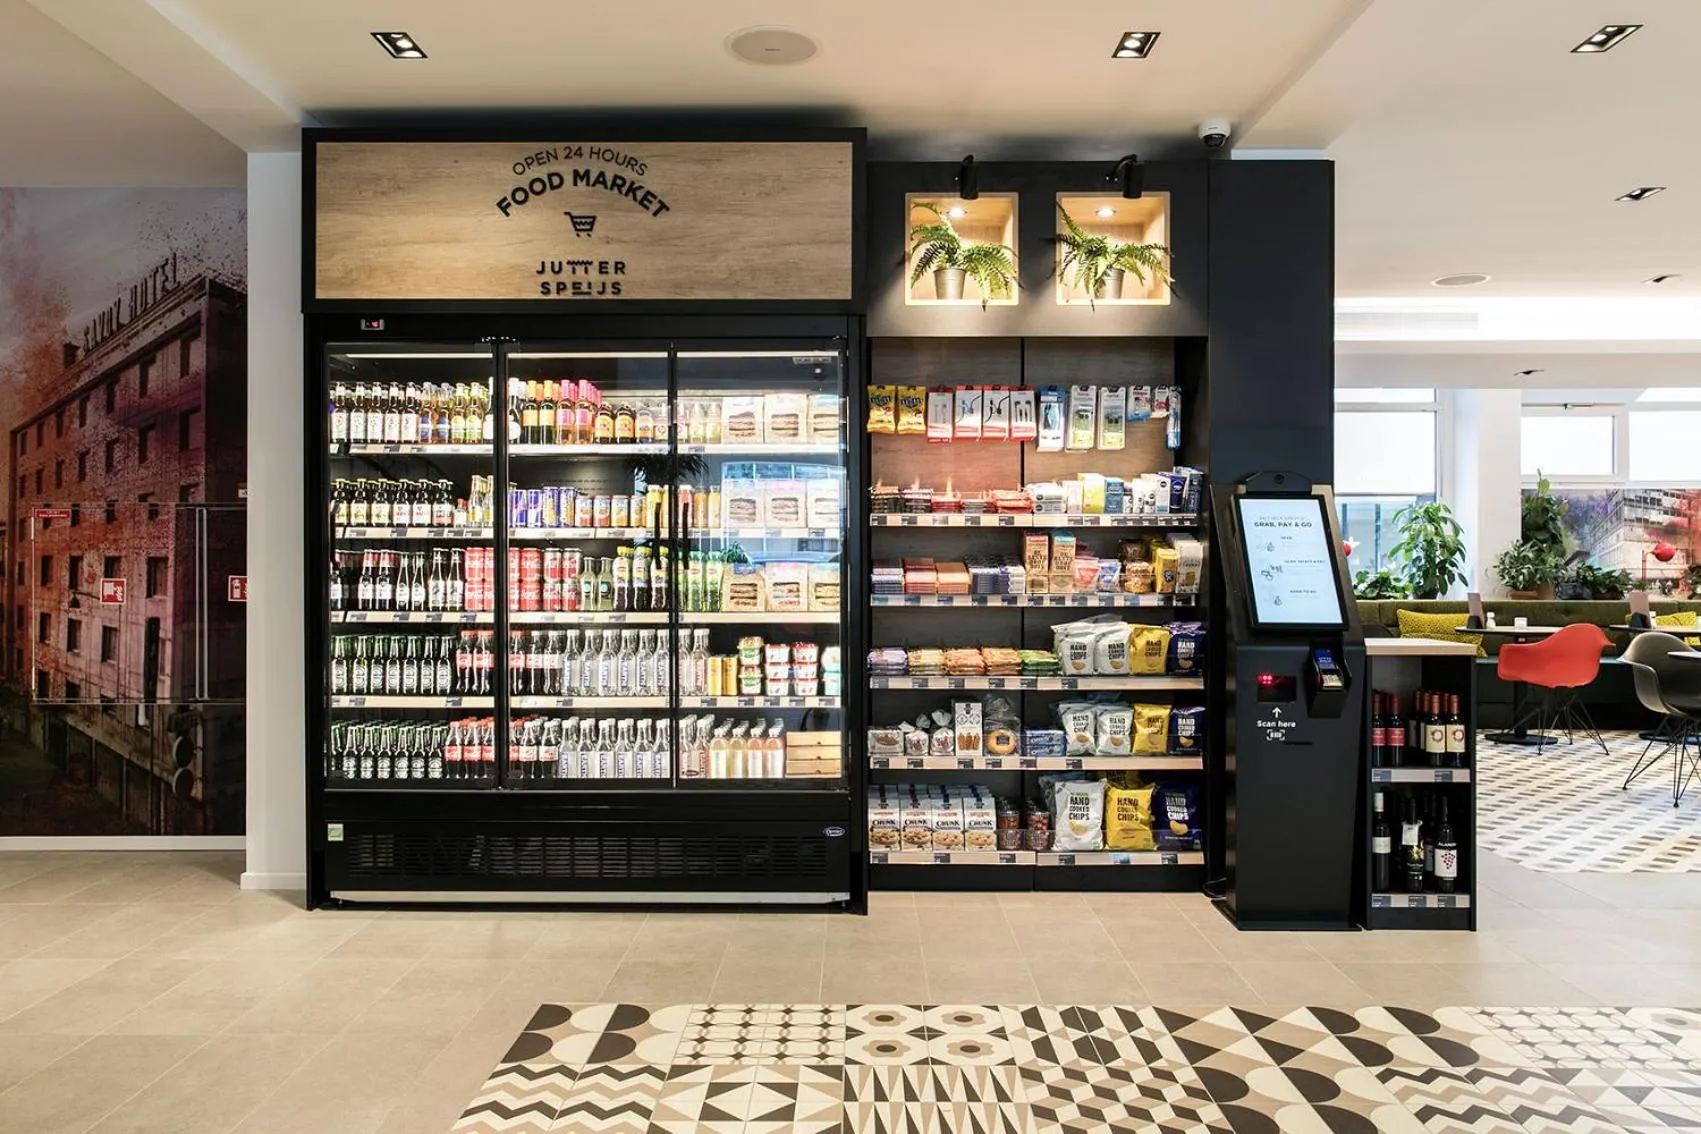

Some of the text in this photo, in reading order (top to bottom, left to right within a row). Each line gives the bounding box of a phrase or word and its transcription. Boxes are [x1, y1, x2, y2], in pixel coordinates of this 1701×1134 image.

[513, 146, 648, 176] OPEN 24 HOURS
[496, 169, 670, 217] FOOD MARKET
[536, 260, 626, 275] JUTTER
[540, 281, 622, 295] SPEIJS
[1256, 720, 1297, 728] Scan here
[1070, 796, 1090, 806] HAND
[1117, 797, 1139, 806] HAND
